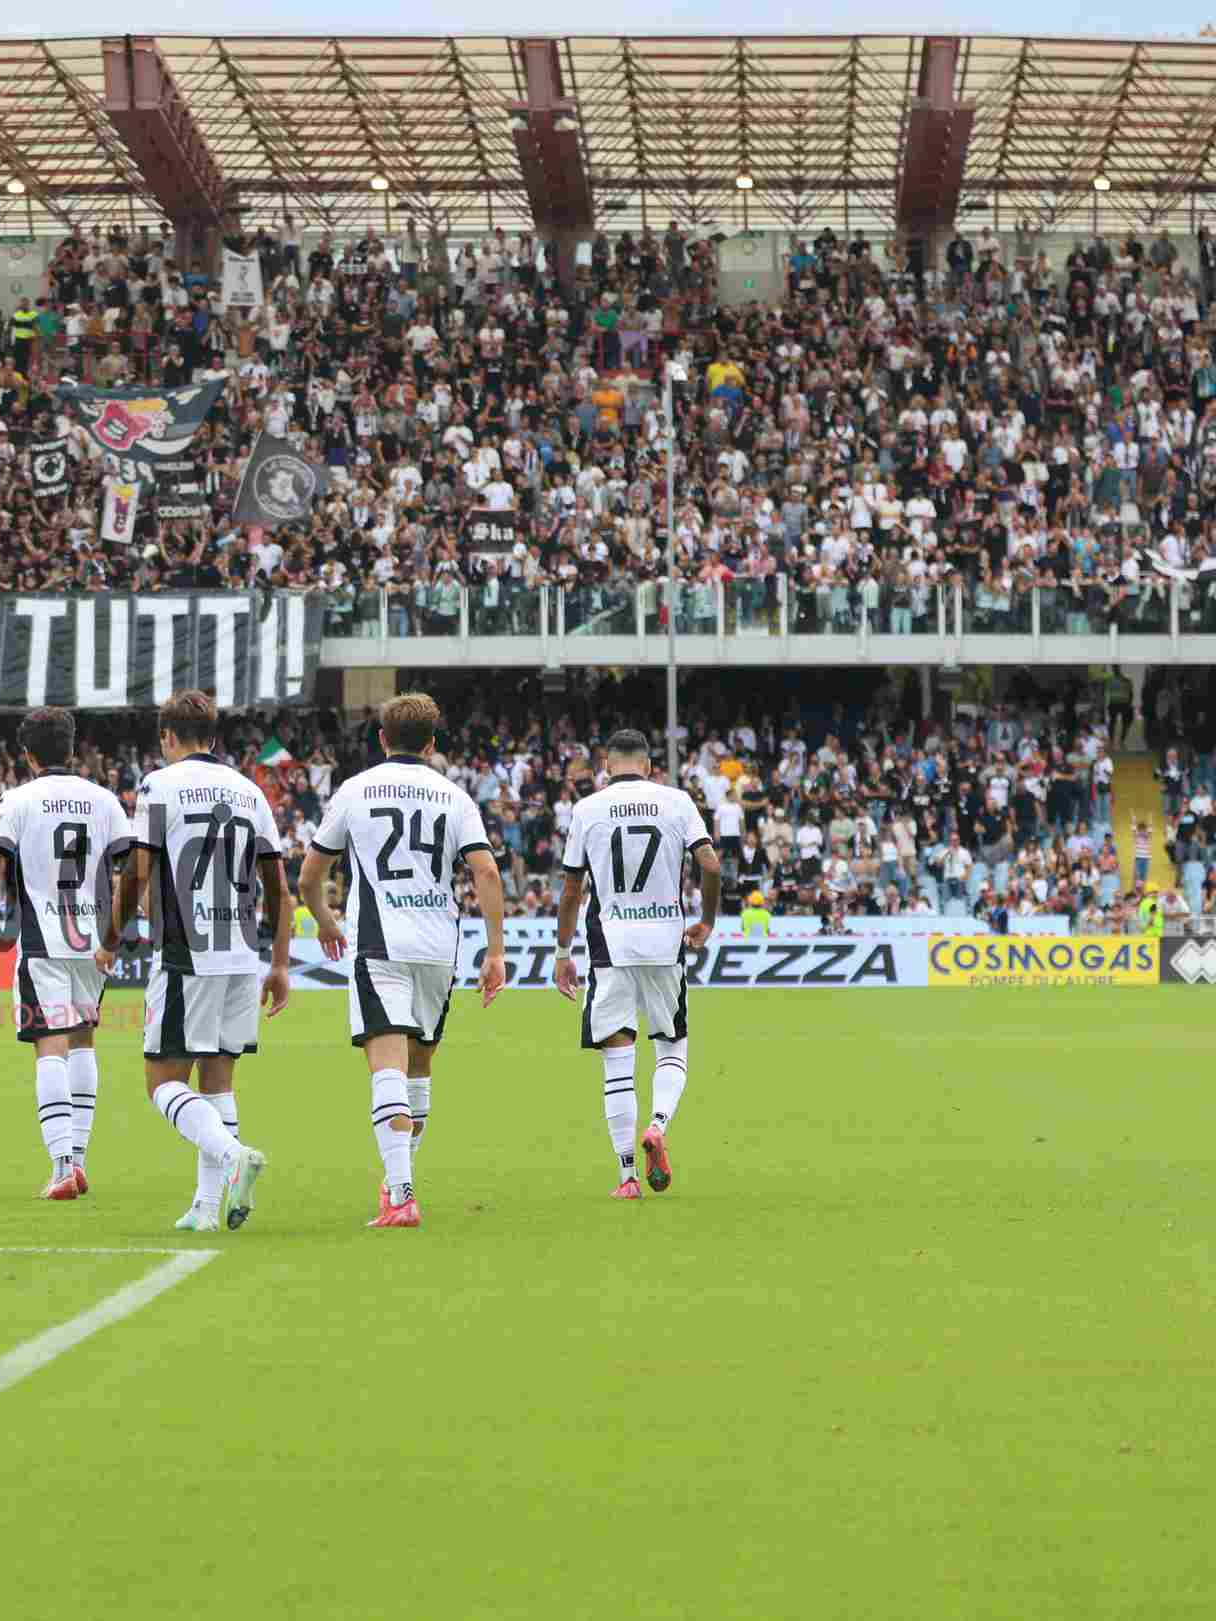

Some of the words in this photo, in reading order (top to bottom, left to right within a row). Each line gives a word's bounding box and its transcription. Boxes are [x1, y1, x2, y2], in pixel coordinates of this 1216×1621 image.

[14, 596, 304, 707] TUTTI!
[53, 822, 88, 890] 9
[184, 812, 256, 893] 70
[369, 807, 447, 883] 24
[610, 825, 663, 894] 17
[610, 900, 680, 920] Amadori
[930, 940, 1154, 974] COSMOGAS
